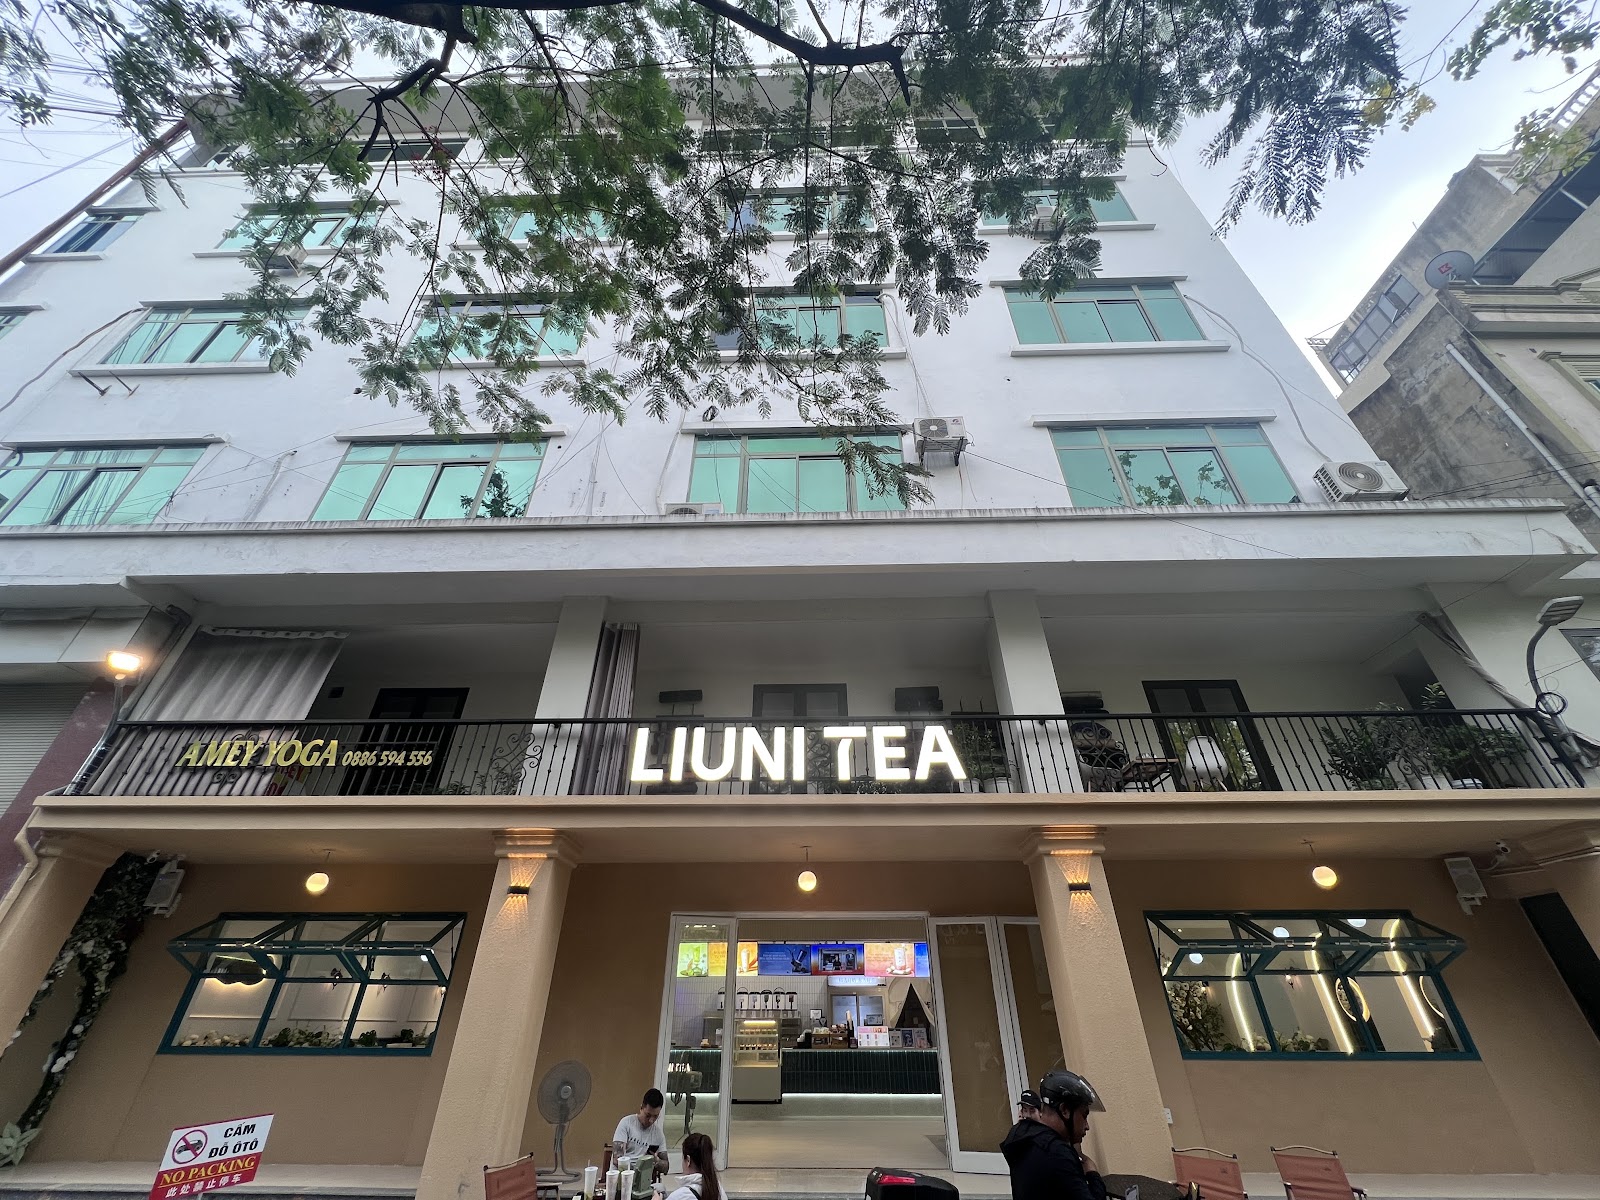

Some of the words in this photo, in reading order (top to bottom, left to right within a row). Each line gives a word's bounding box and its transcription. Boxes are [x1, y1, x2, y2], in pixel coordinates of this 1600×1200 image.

[175, 740, 262, 767] AMEY
[262, 739, 339, 767] YOGA
[342, 750, 378, 767] 0886
[378, 750, 405, 767] 594
[407, 750, 433, 766] 556
[630, 726, 805, 782] LIUNI
[823, 725, 967, 780] TEA
[224, 1122, 256, 1138] CẤM
[232, 1138, 259, 1154] ÔTÔ
[160, 1171, 185, 1186] NO
[189, 1156, 256, 1180] PACKING
